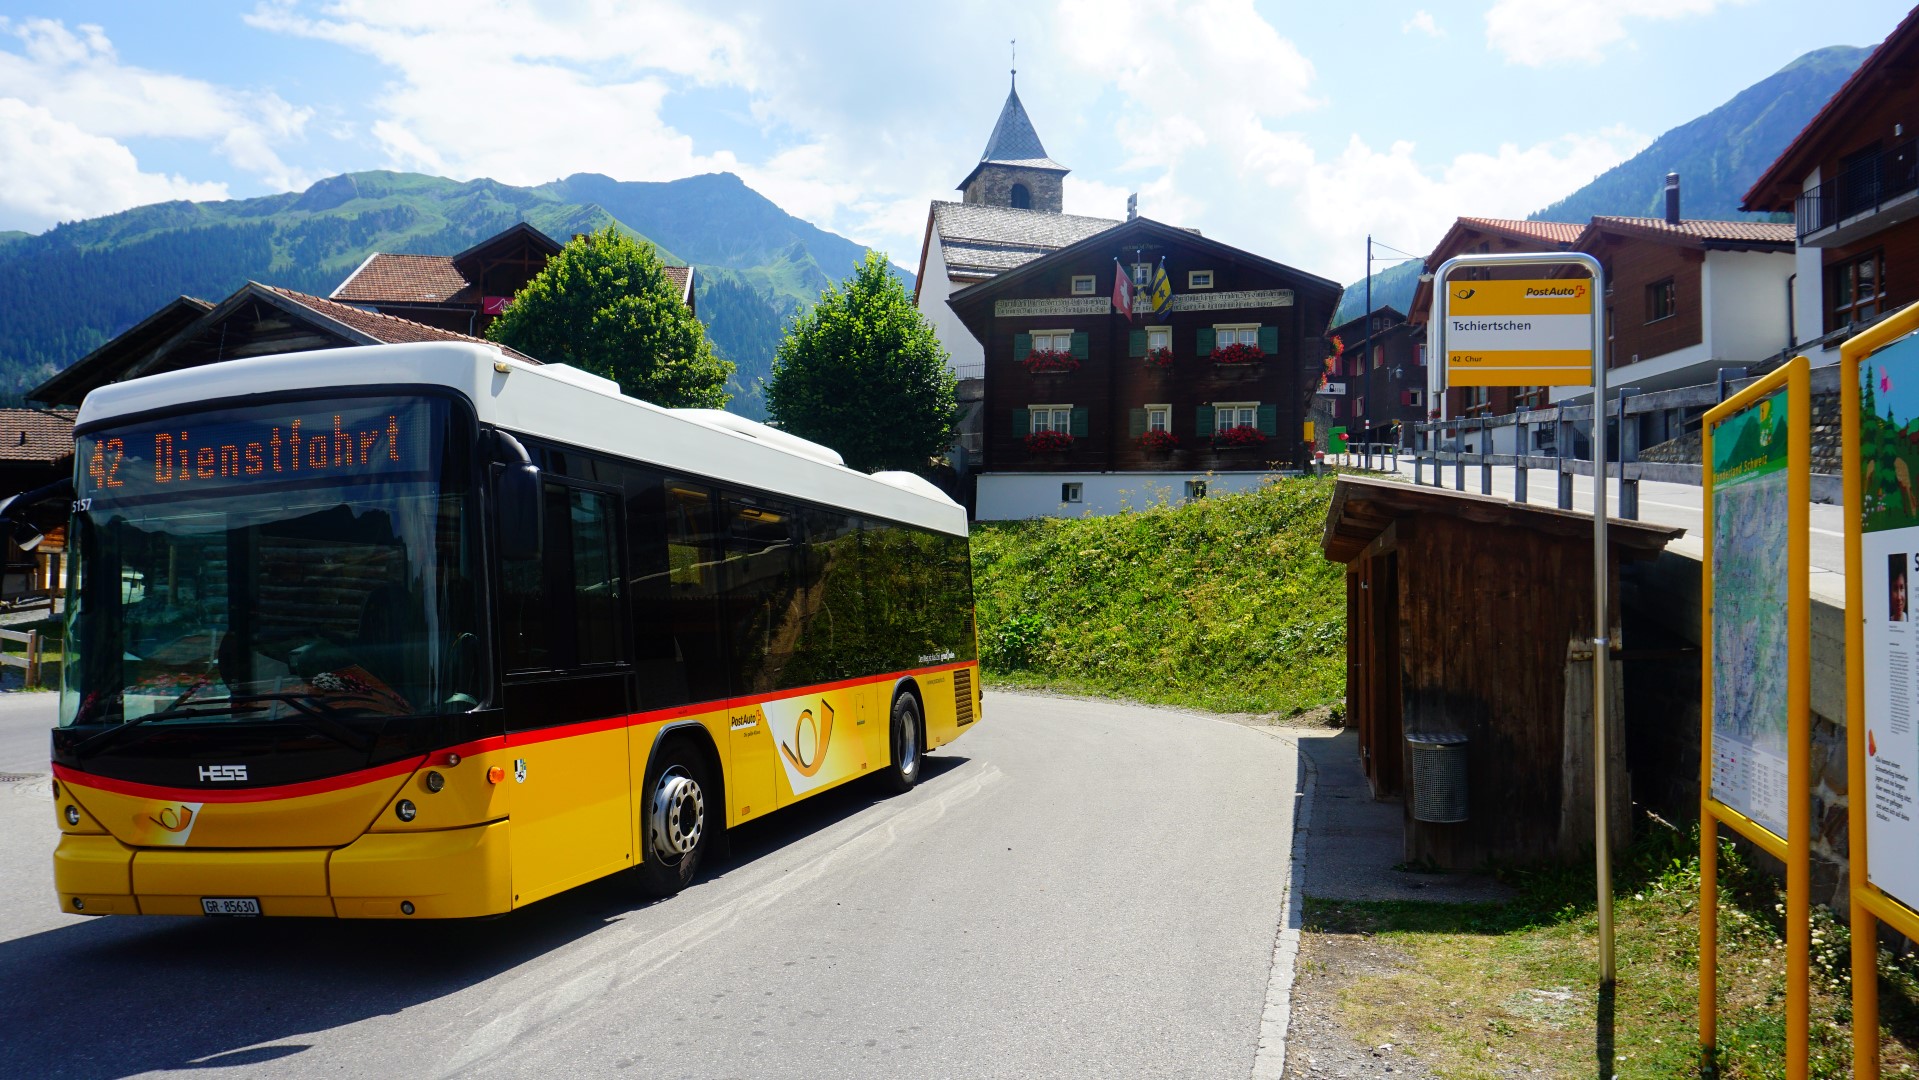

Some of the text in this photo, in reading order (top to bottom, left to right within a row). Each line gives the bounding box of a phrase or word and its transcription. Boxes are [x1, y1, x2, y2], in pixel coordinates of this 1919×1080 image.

[1526, 287, 1575, 297] PostAuto
[1453, 321, 1531, 331] Tschiertschen
[89, 415, 399, 488] 42 Dienstfahrt
[72, 498, 92, 513] 5157
[731, 714, 756, 727] PostAuto
[198, 764, 248, 781] HESS
[224, 900, 255, 913] 85630
